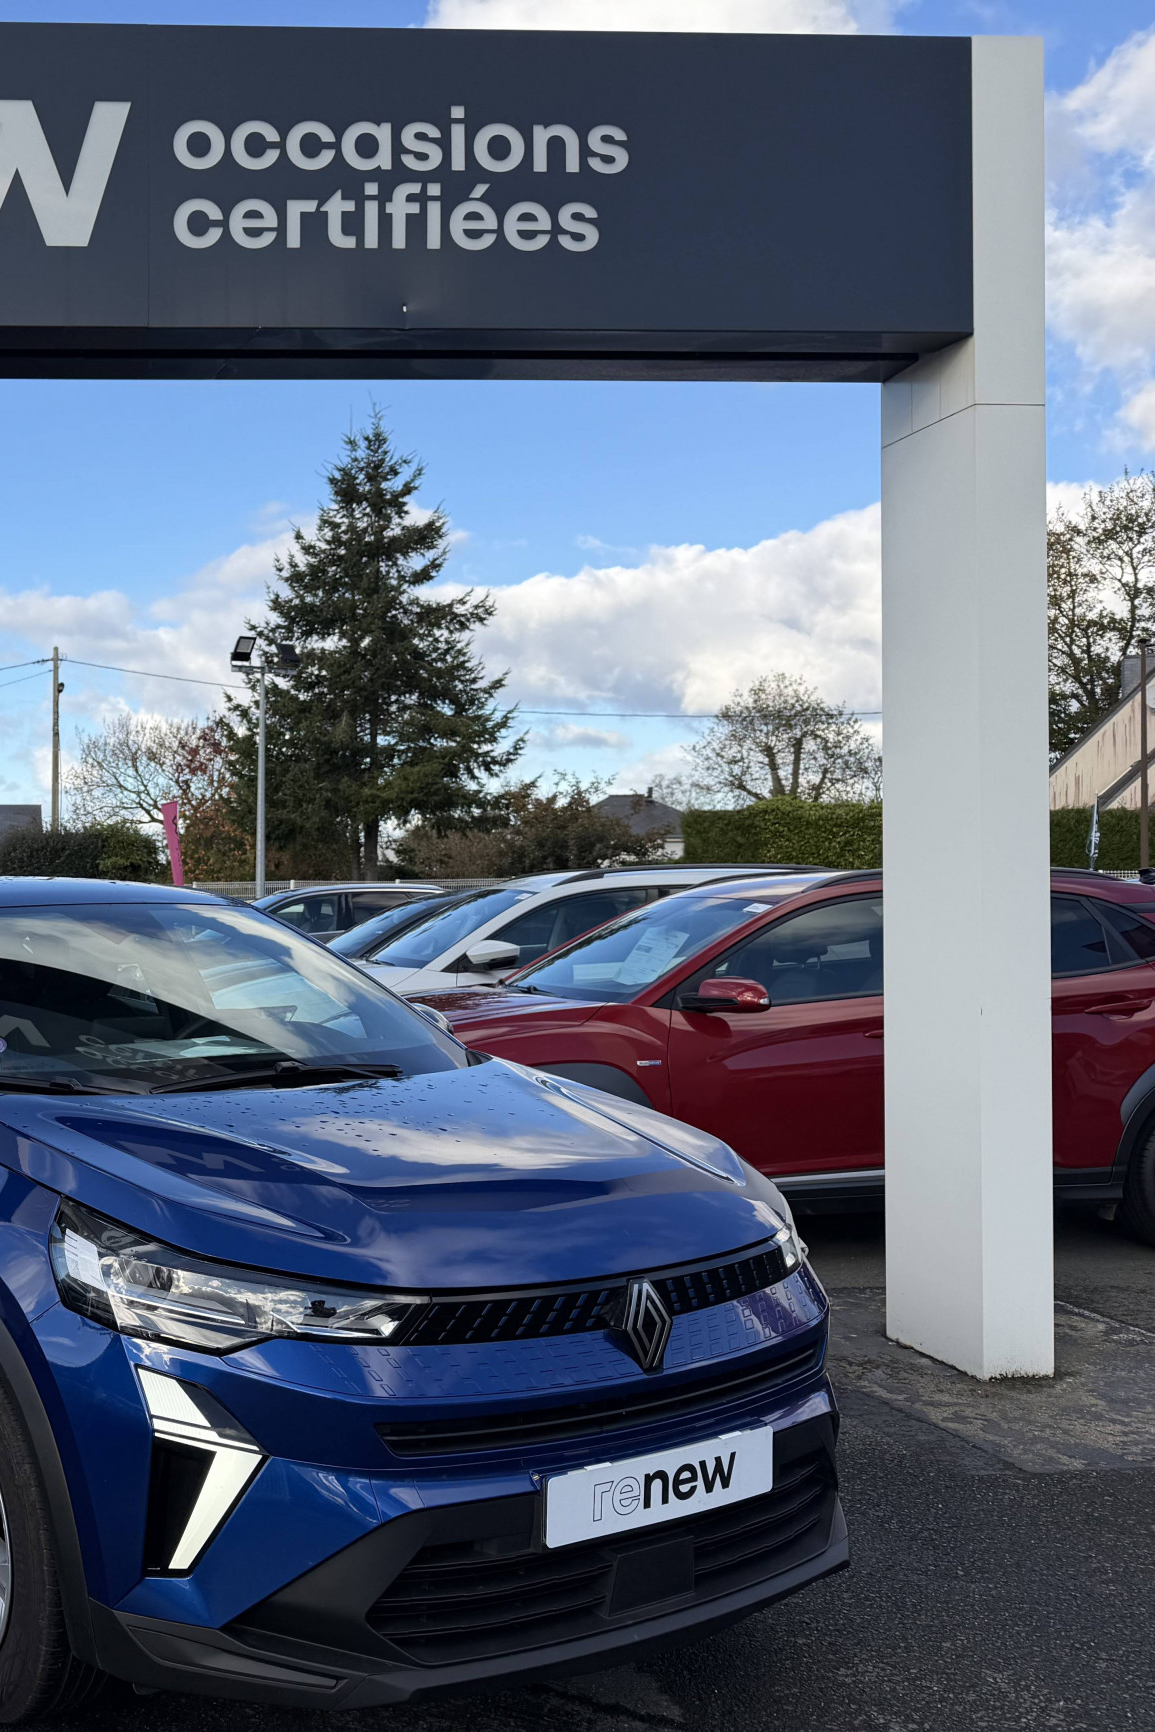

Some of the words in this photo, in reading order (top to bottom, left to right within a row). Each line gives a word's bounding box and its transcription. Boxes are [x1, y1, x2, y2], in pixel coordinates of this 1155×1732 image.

[173, 106, 629, 174] occasions
[173, 182, 600, 252] certifiées
[592, 1451, 737, 1522] renew
